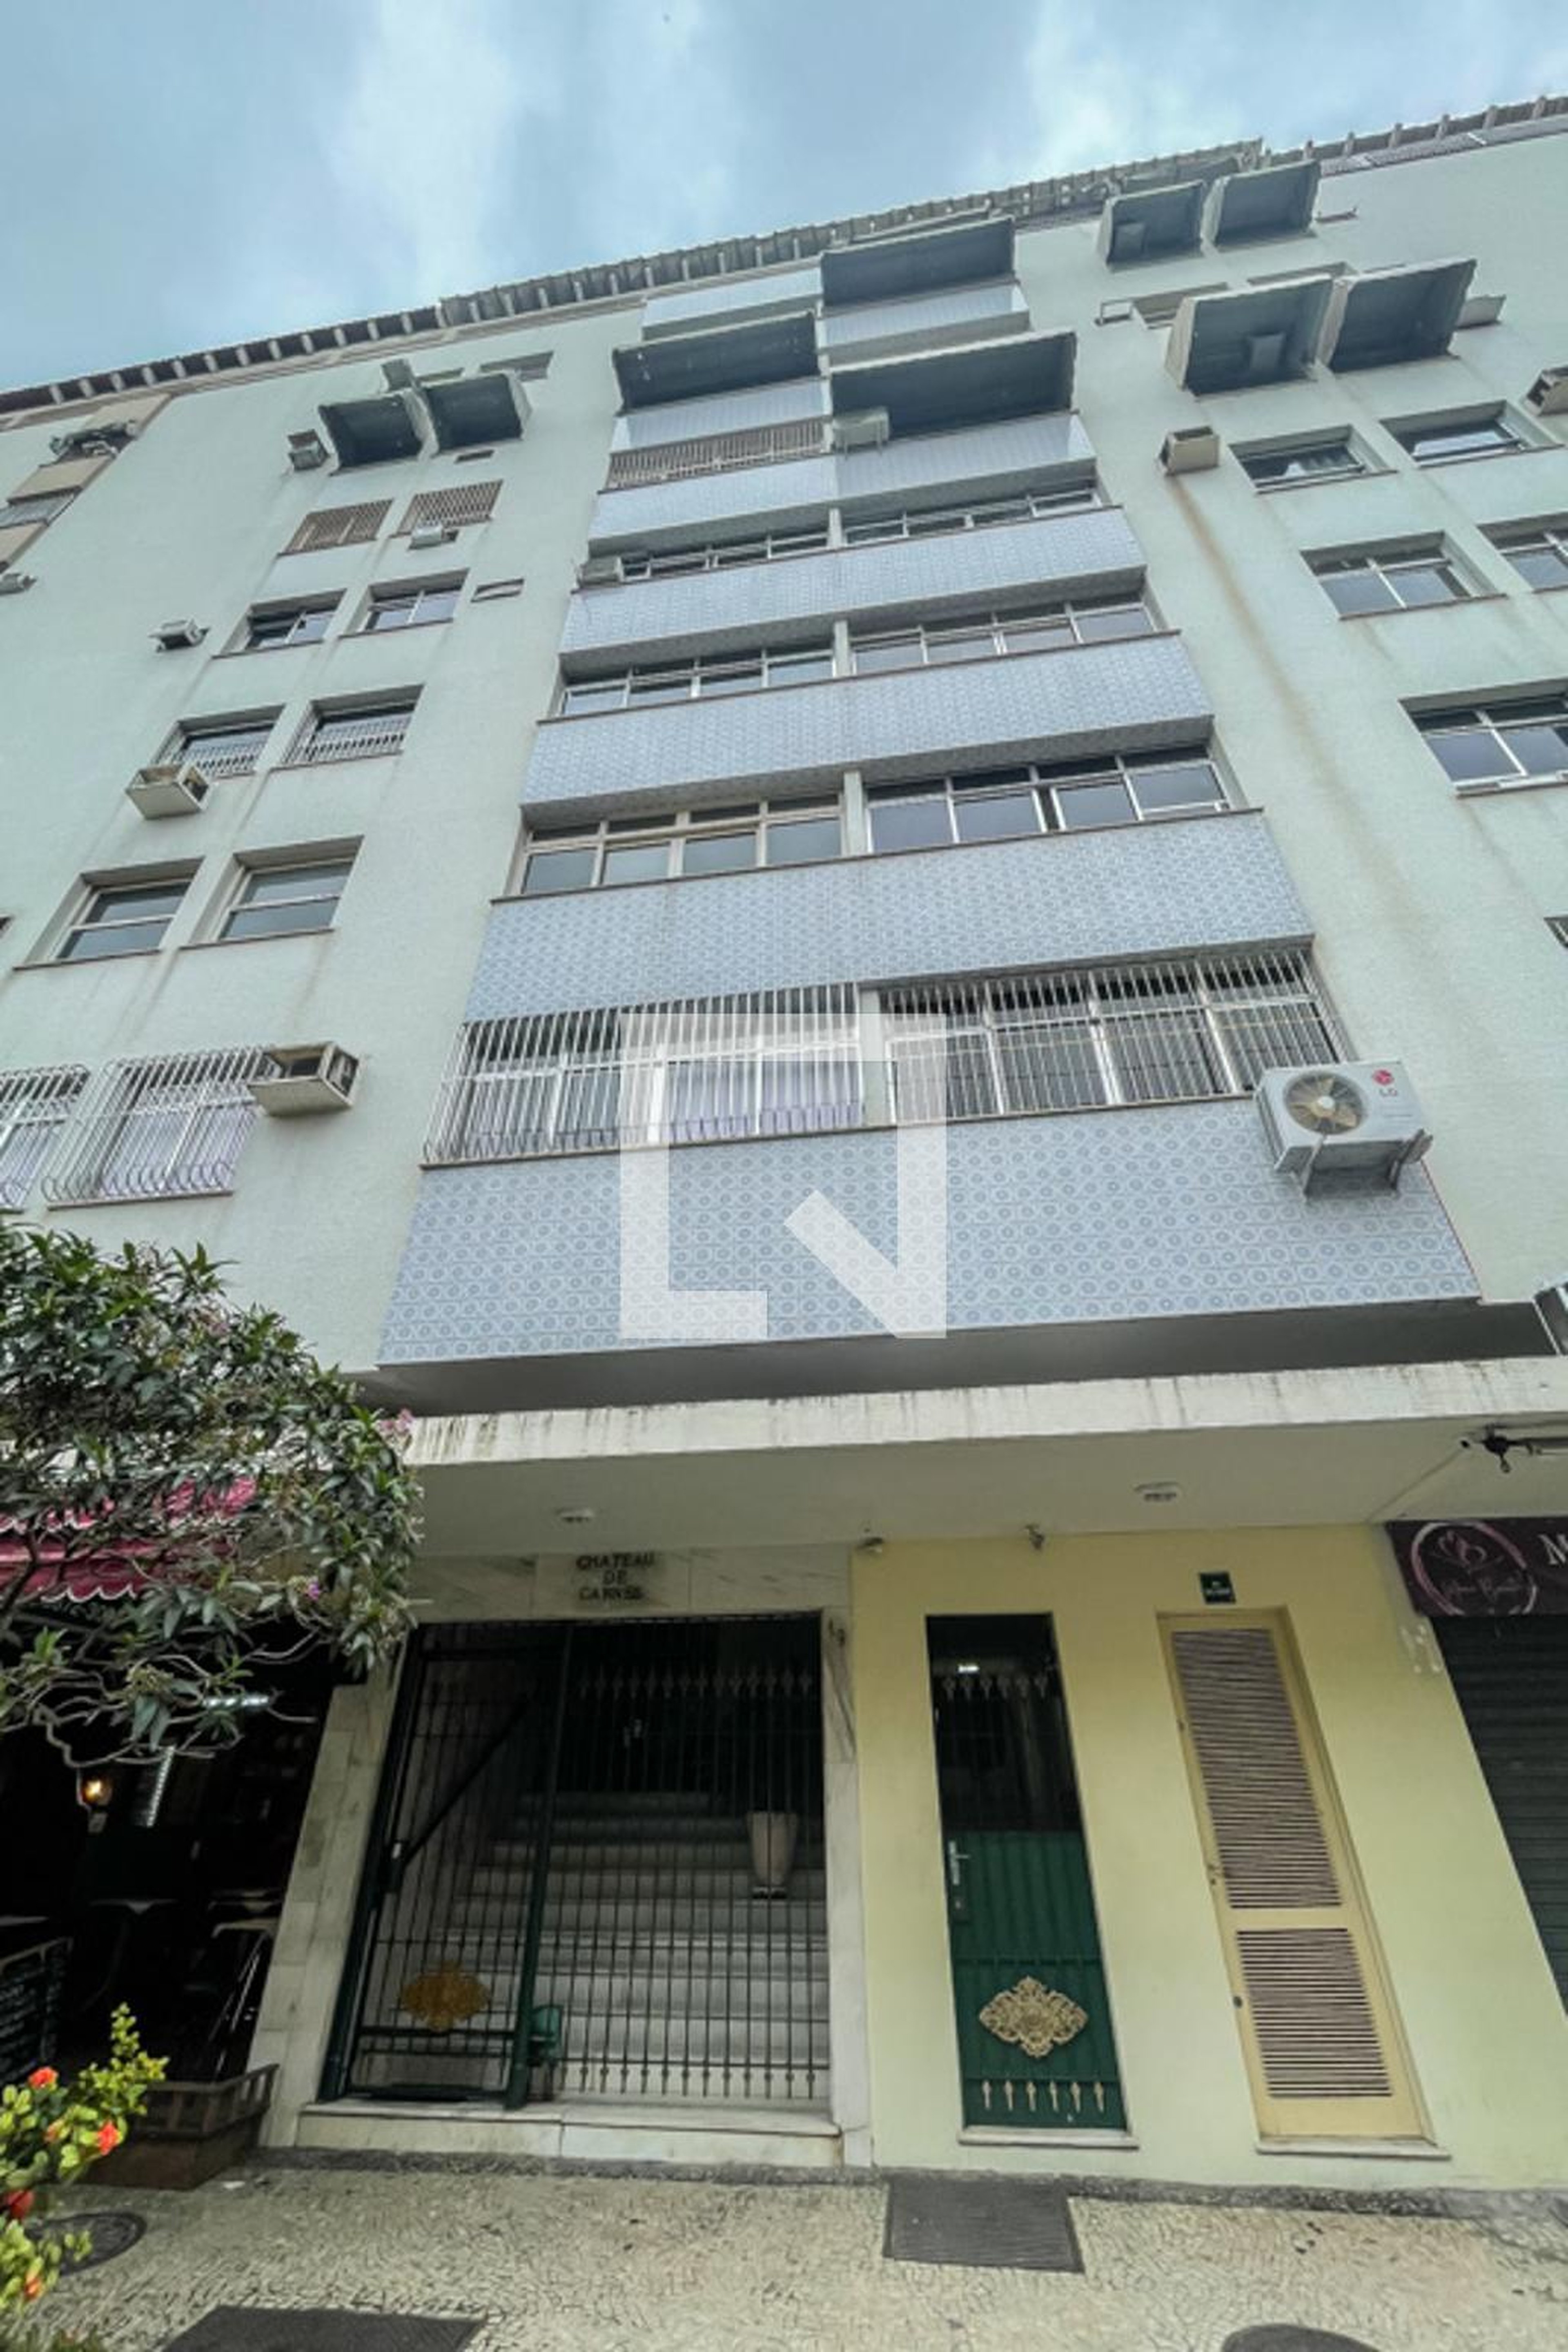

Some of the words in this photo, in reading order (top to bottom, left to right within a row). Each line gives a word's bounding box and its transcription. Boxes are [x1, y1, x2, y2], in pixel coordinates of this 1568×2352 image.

[1379, 1088, 1398, 1098] LG
[576, 1552, 655, 1570] CHATEAU
[603, 1570, 627, 1584] DE
